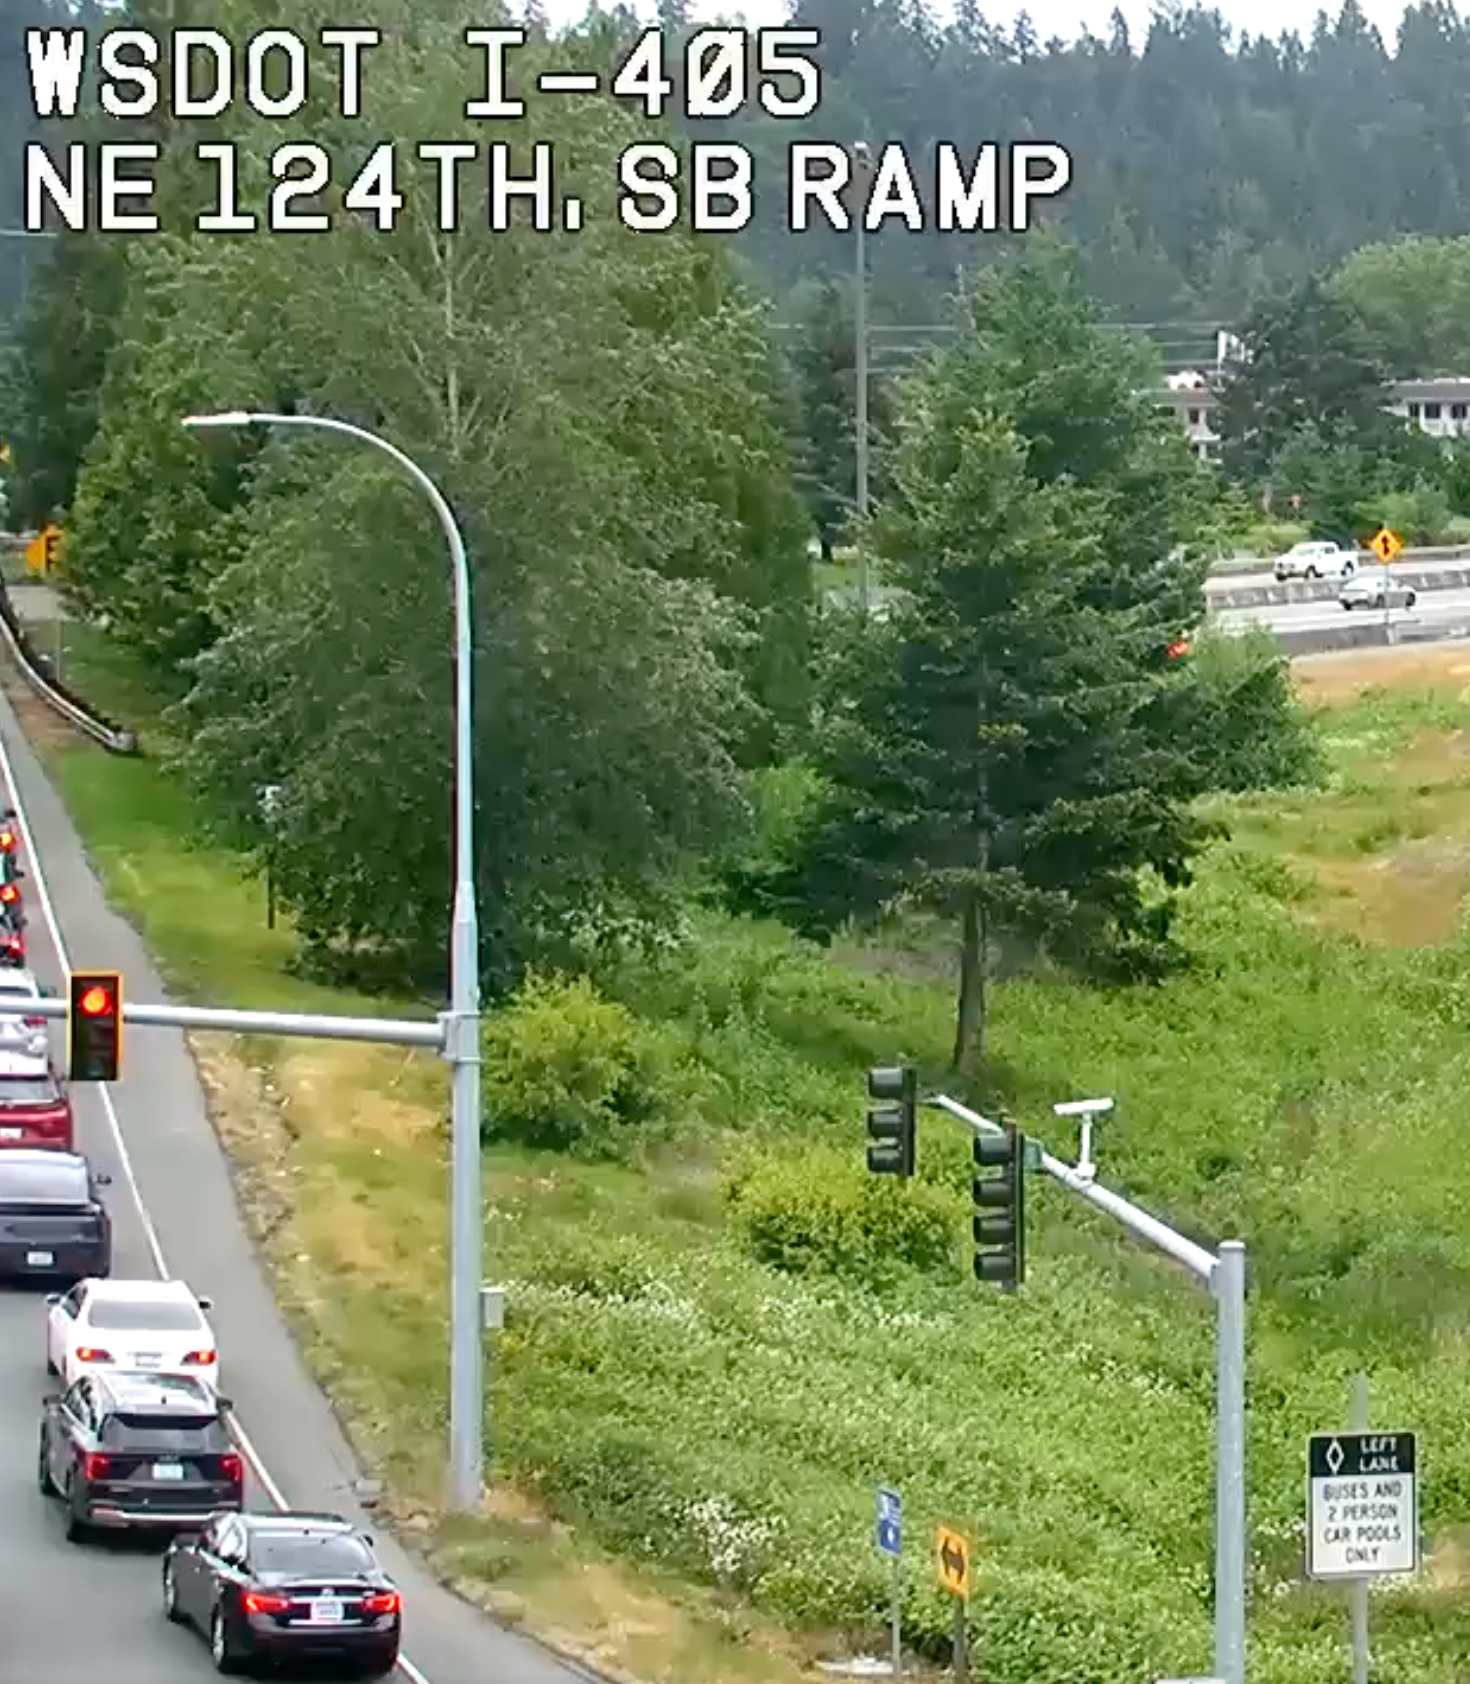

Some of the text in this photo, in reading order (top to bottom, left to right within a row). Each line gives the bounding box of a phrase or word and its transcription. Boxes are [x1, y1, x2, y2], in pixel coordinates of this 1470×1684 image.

[1360, 1437, 1397, 1453] LEFT
[1360, 1456, 1398, 1472] LANE
[1323, 1481, 1402, 1500] BUSES AND
[1328, 1503, 1397, 1522] 2 PERSON
[1323, 1524, 1401, 1544] CAR POOLS
[1345, 1547, 1380, 1563] ONLY
